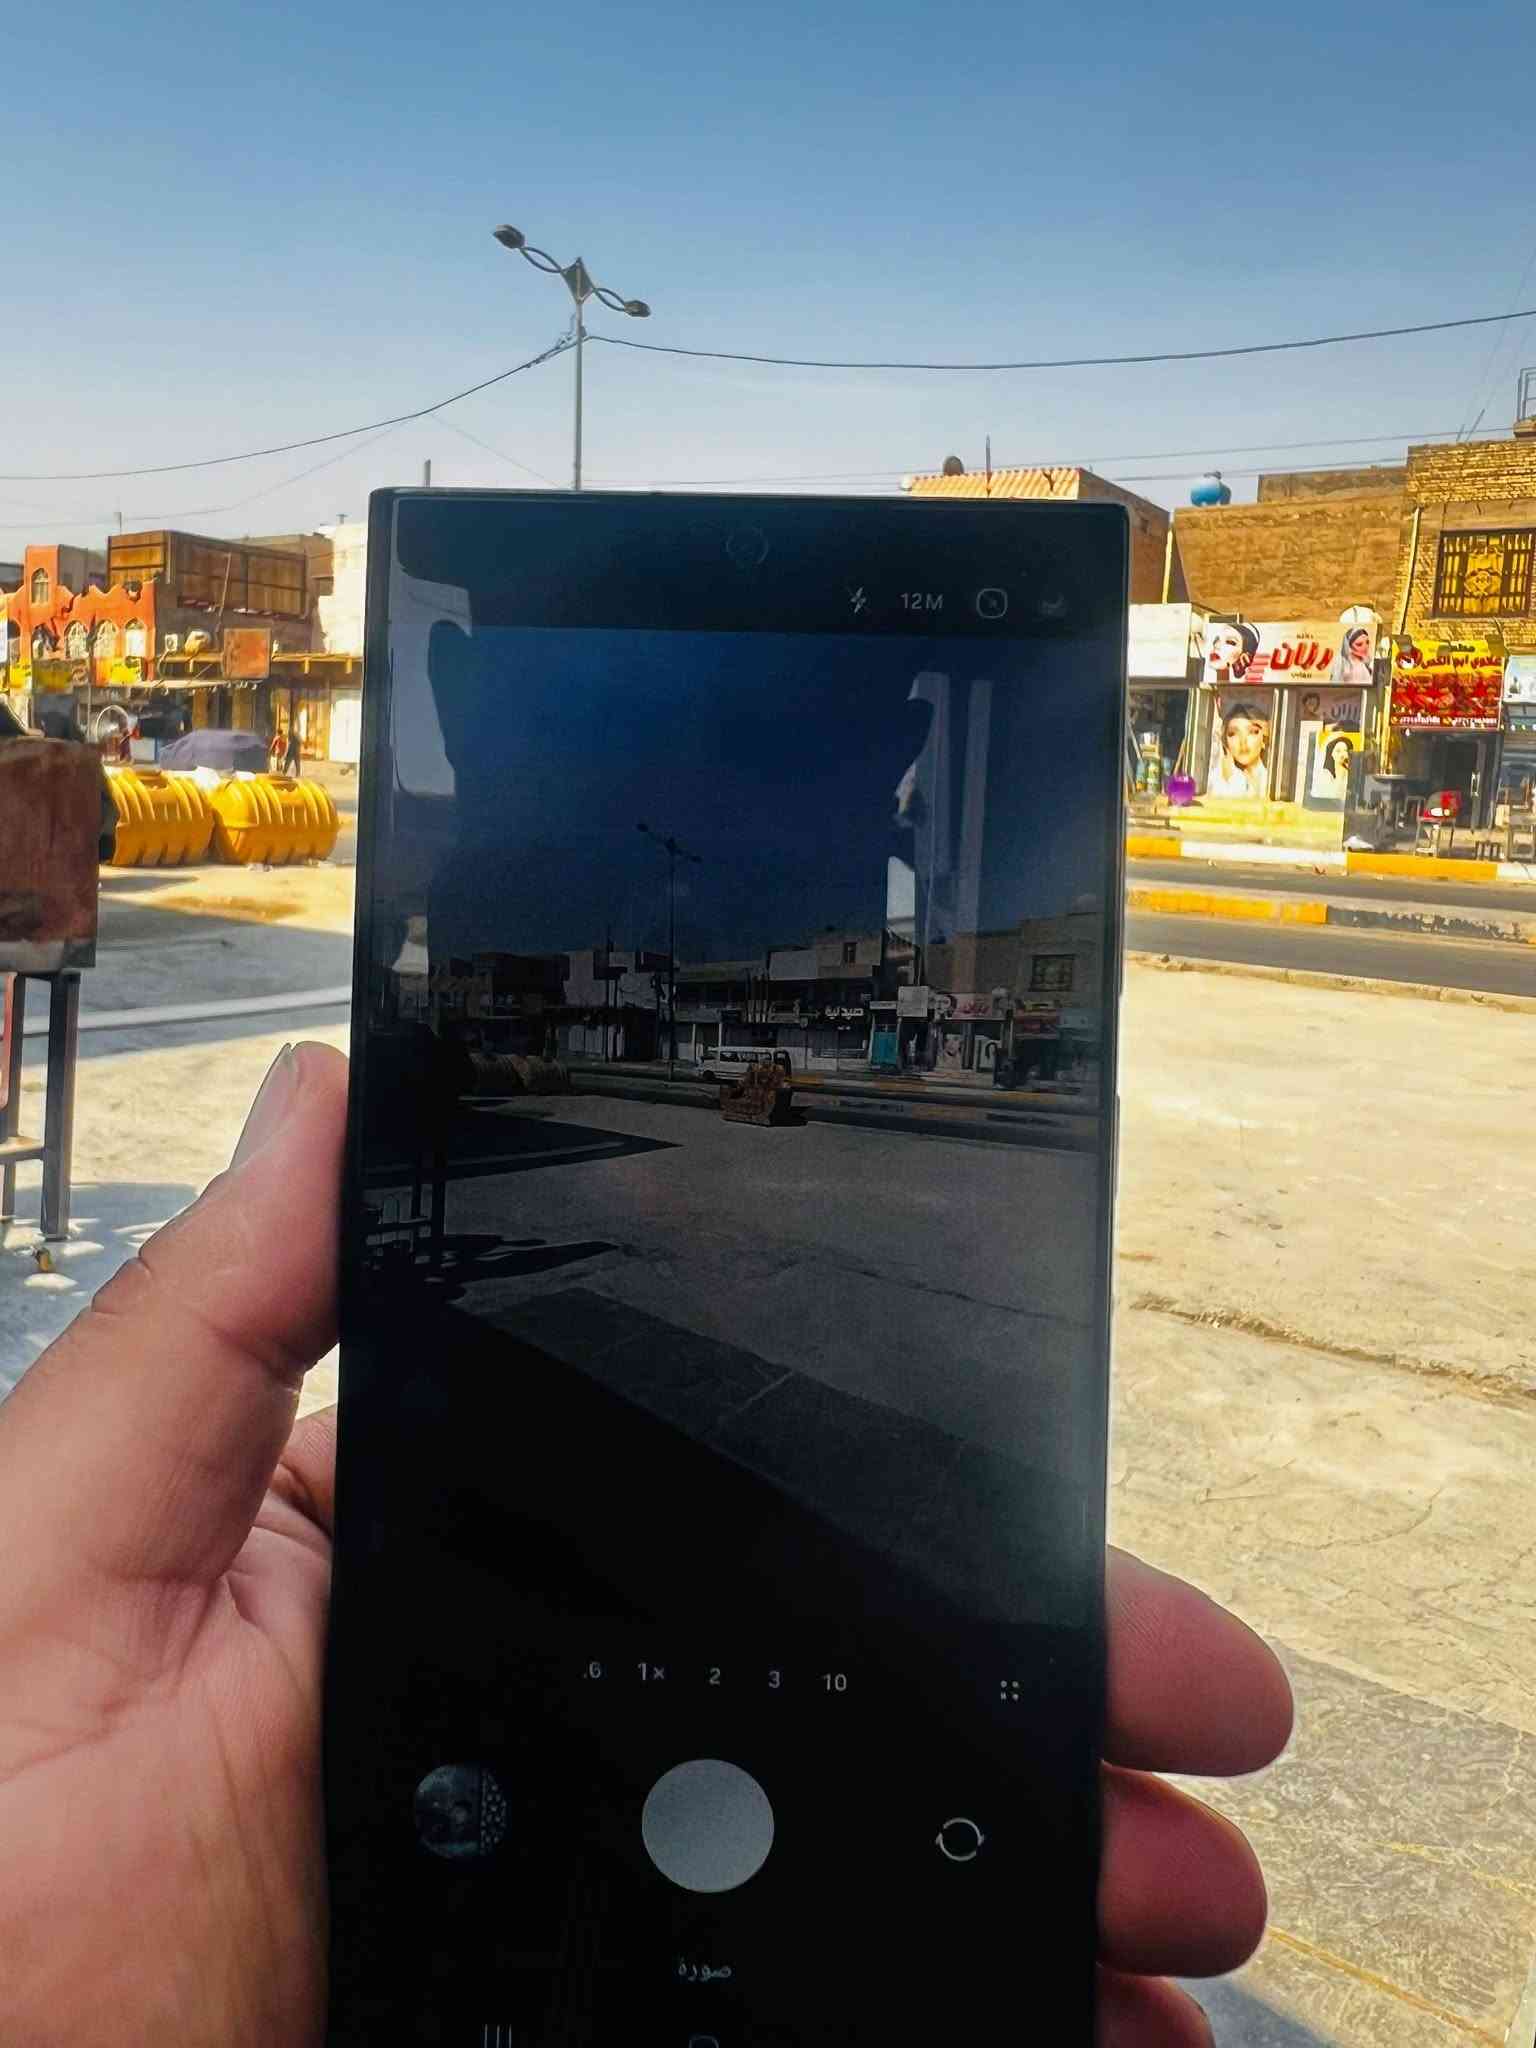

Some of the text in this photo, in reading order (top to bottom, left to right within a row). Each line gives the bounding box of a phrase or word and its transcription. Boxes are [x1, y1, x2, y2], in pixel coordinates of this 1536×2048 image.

[900, 592, 944, 610] 12M
[709, 1668, 722, 1685] 2
[768, 1671, 781, 1688] 3
[823, 1673, 848, 1691] 10
[677, 1956, 733, 1983] صورة
